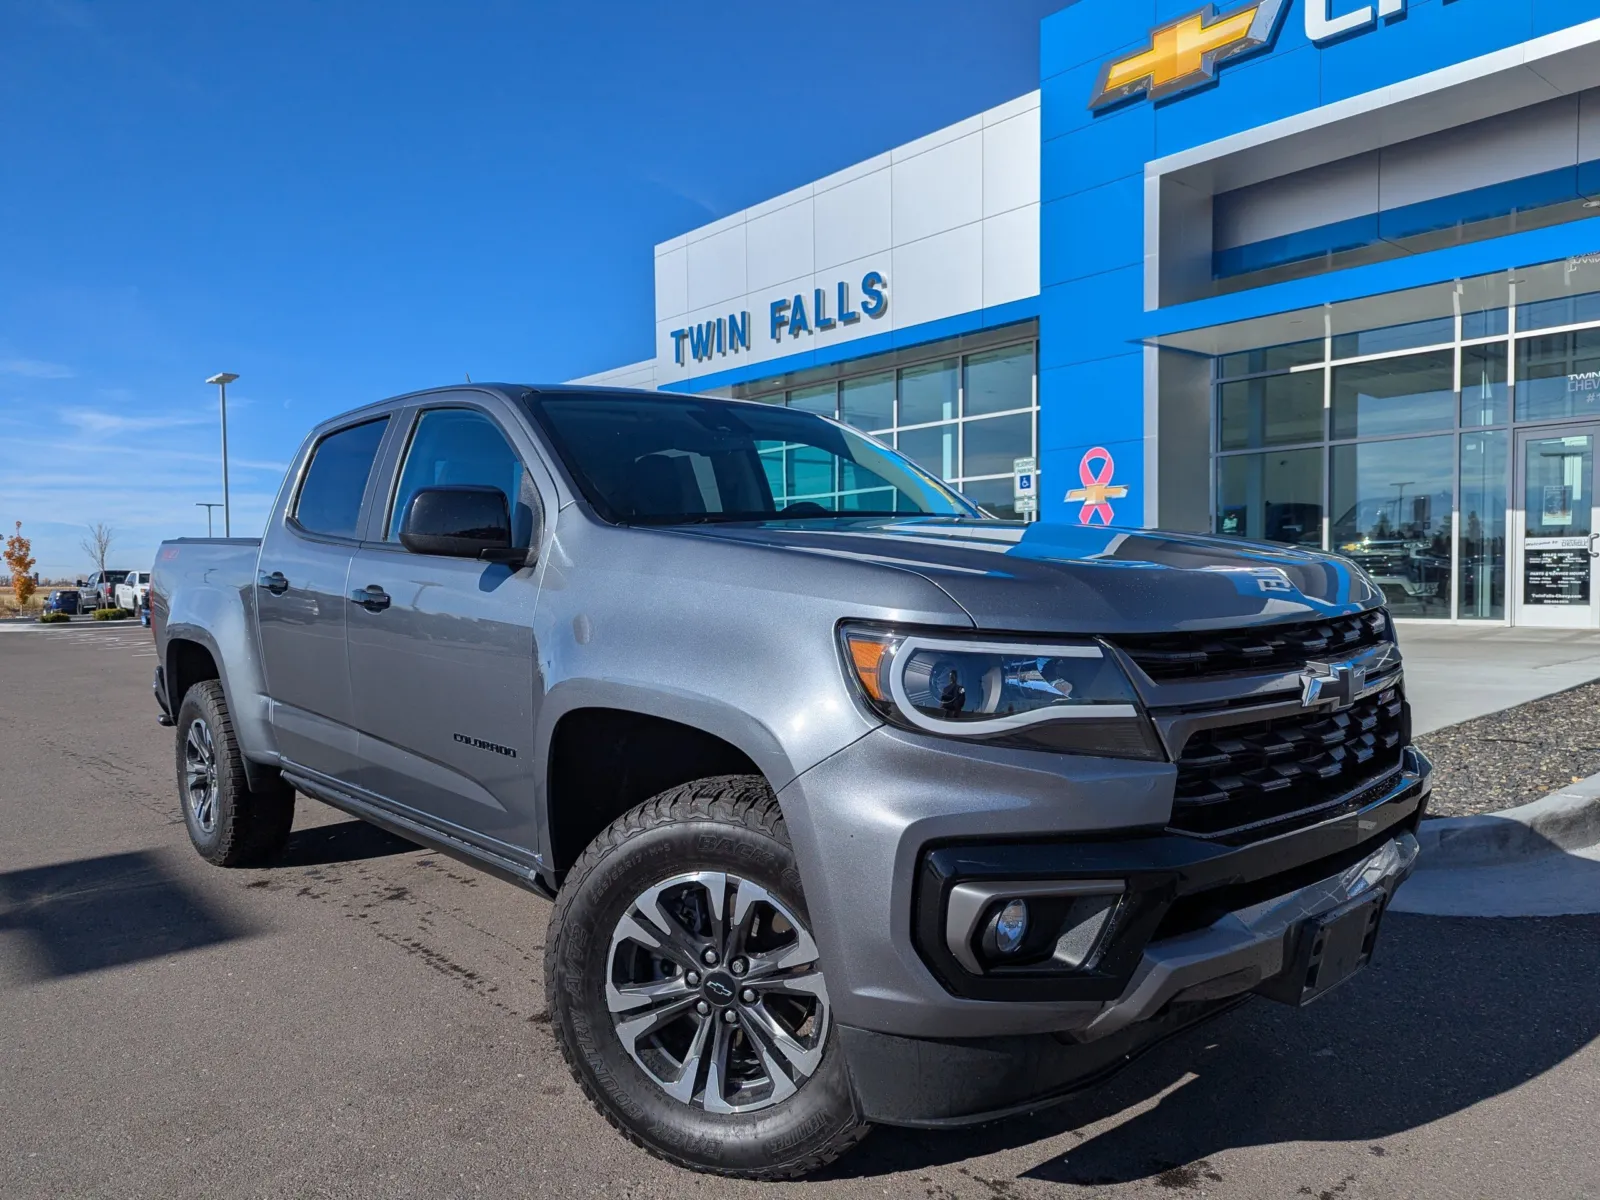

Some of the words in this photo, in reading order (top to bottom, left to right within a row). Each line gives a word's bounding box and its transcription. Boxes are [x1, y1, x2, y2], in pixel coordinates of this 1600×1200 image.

[670, 311, 751, 367] TWIN
[770, 271, 888, 343] FALLS
[1567, 371, 1600, 381] TWIN
[453, 732, 517, 758] COLORADO
[697, 834, 775, 863] BACK
[574, 1008, 644, 1121] COUNTRY
[649, 1117, 725, 1159] BACK
